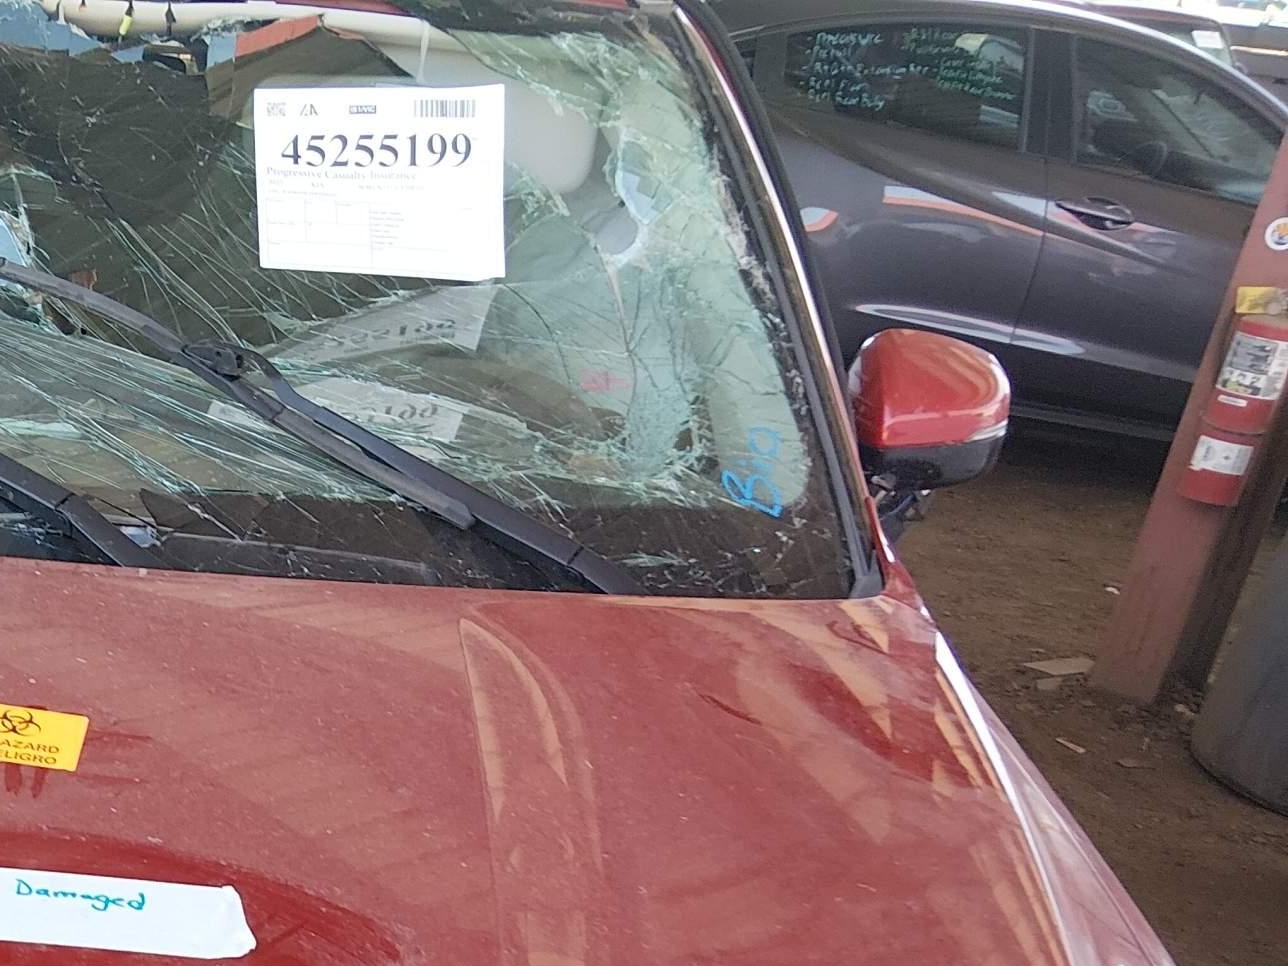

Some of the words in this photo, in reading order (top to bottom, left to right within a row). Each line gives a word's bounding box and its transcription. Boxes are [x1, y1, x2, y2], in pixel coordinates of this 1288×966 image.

[280, 133, 472, 168] 45255199
[266, 166, 322, 179] Progressive
[325, 168, 366, 181] Casualty
[16, 878, 146, 912] Damaged
